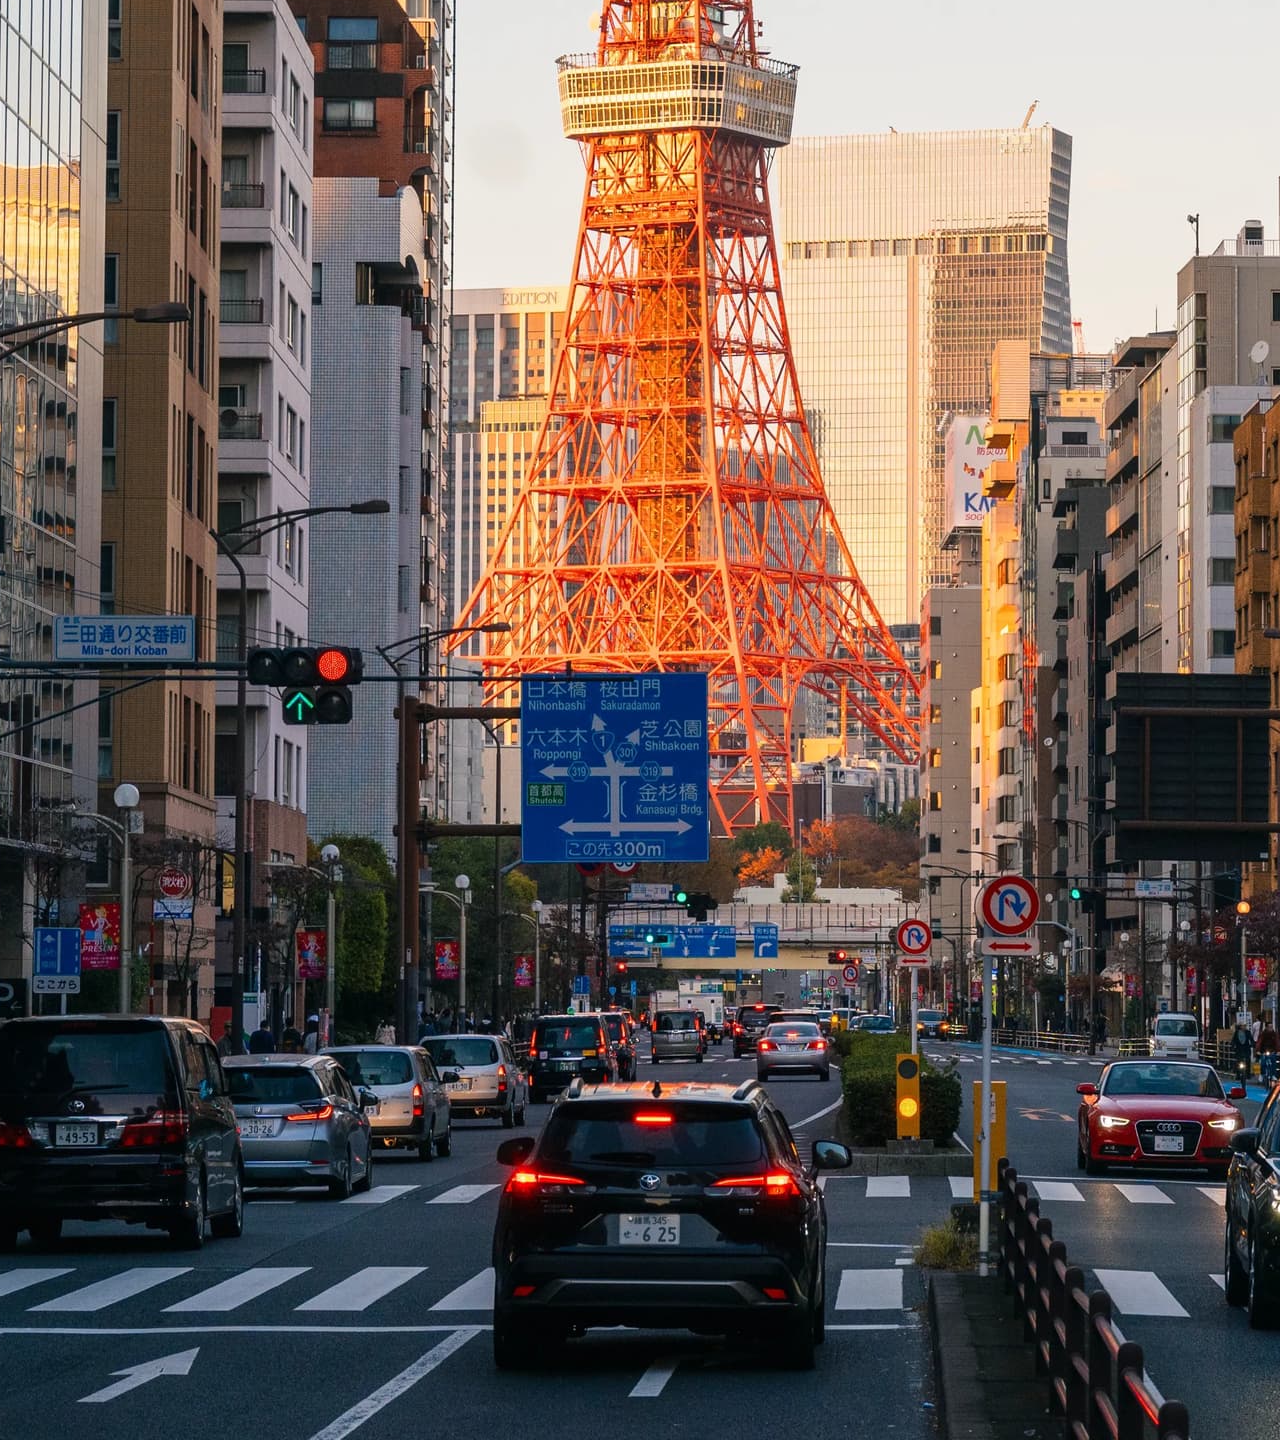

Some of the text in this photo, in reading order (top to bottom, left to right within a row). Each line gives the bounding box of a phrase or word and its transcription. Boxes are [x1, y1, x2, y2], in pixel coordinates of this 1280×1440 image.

[501, 291, 558, 305] EDITION
[63, 624, 187, 644] 三田通り交番前
[81, 645, 168, 656] Mita-dori Koban
[527, 679, 661, 698] 日本橋 桜田門
[528, 700, 661, 711] Nihonbashi Sakuradamon
[640, 719, 702, 738] 芝公園
[527, 727, 588, 747] 六本木
[619, 747, 634, 757] 301
[644, 741, 700, 751] Shibakoen
[533, 749, 582, 760] Roppongi
[572, 765, 586, 777] 319
[643, 765, 658, 777] 319
[639, 783, 698, 802] 金杉橋
[636, 804, 704, 815] Kanasugi Brdg.
[36, 979, 78, 991] ここから
